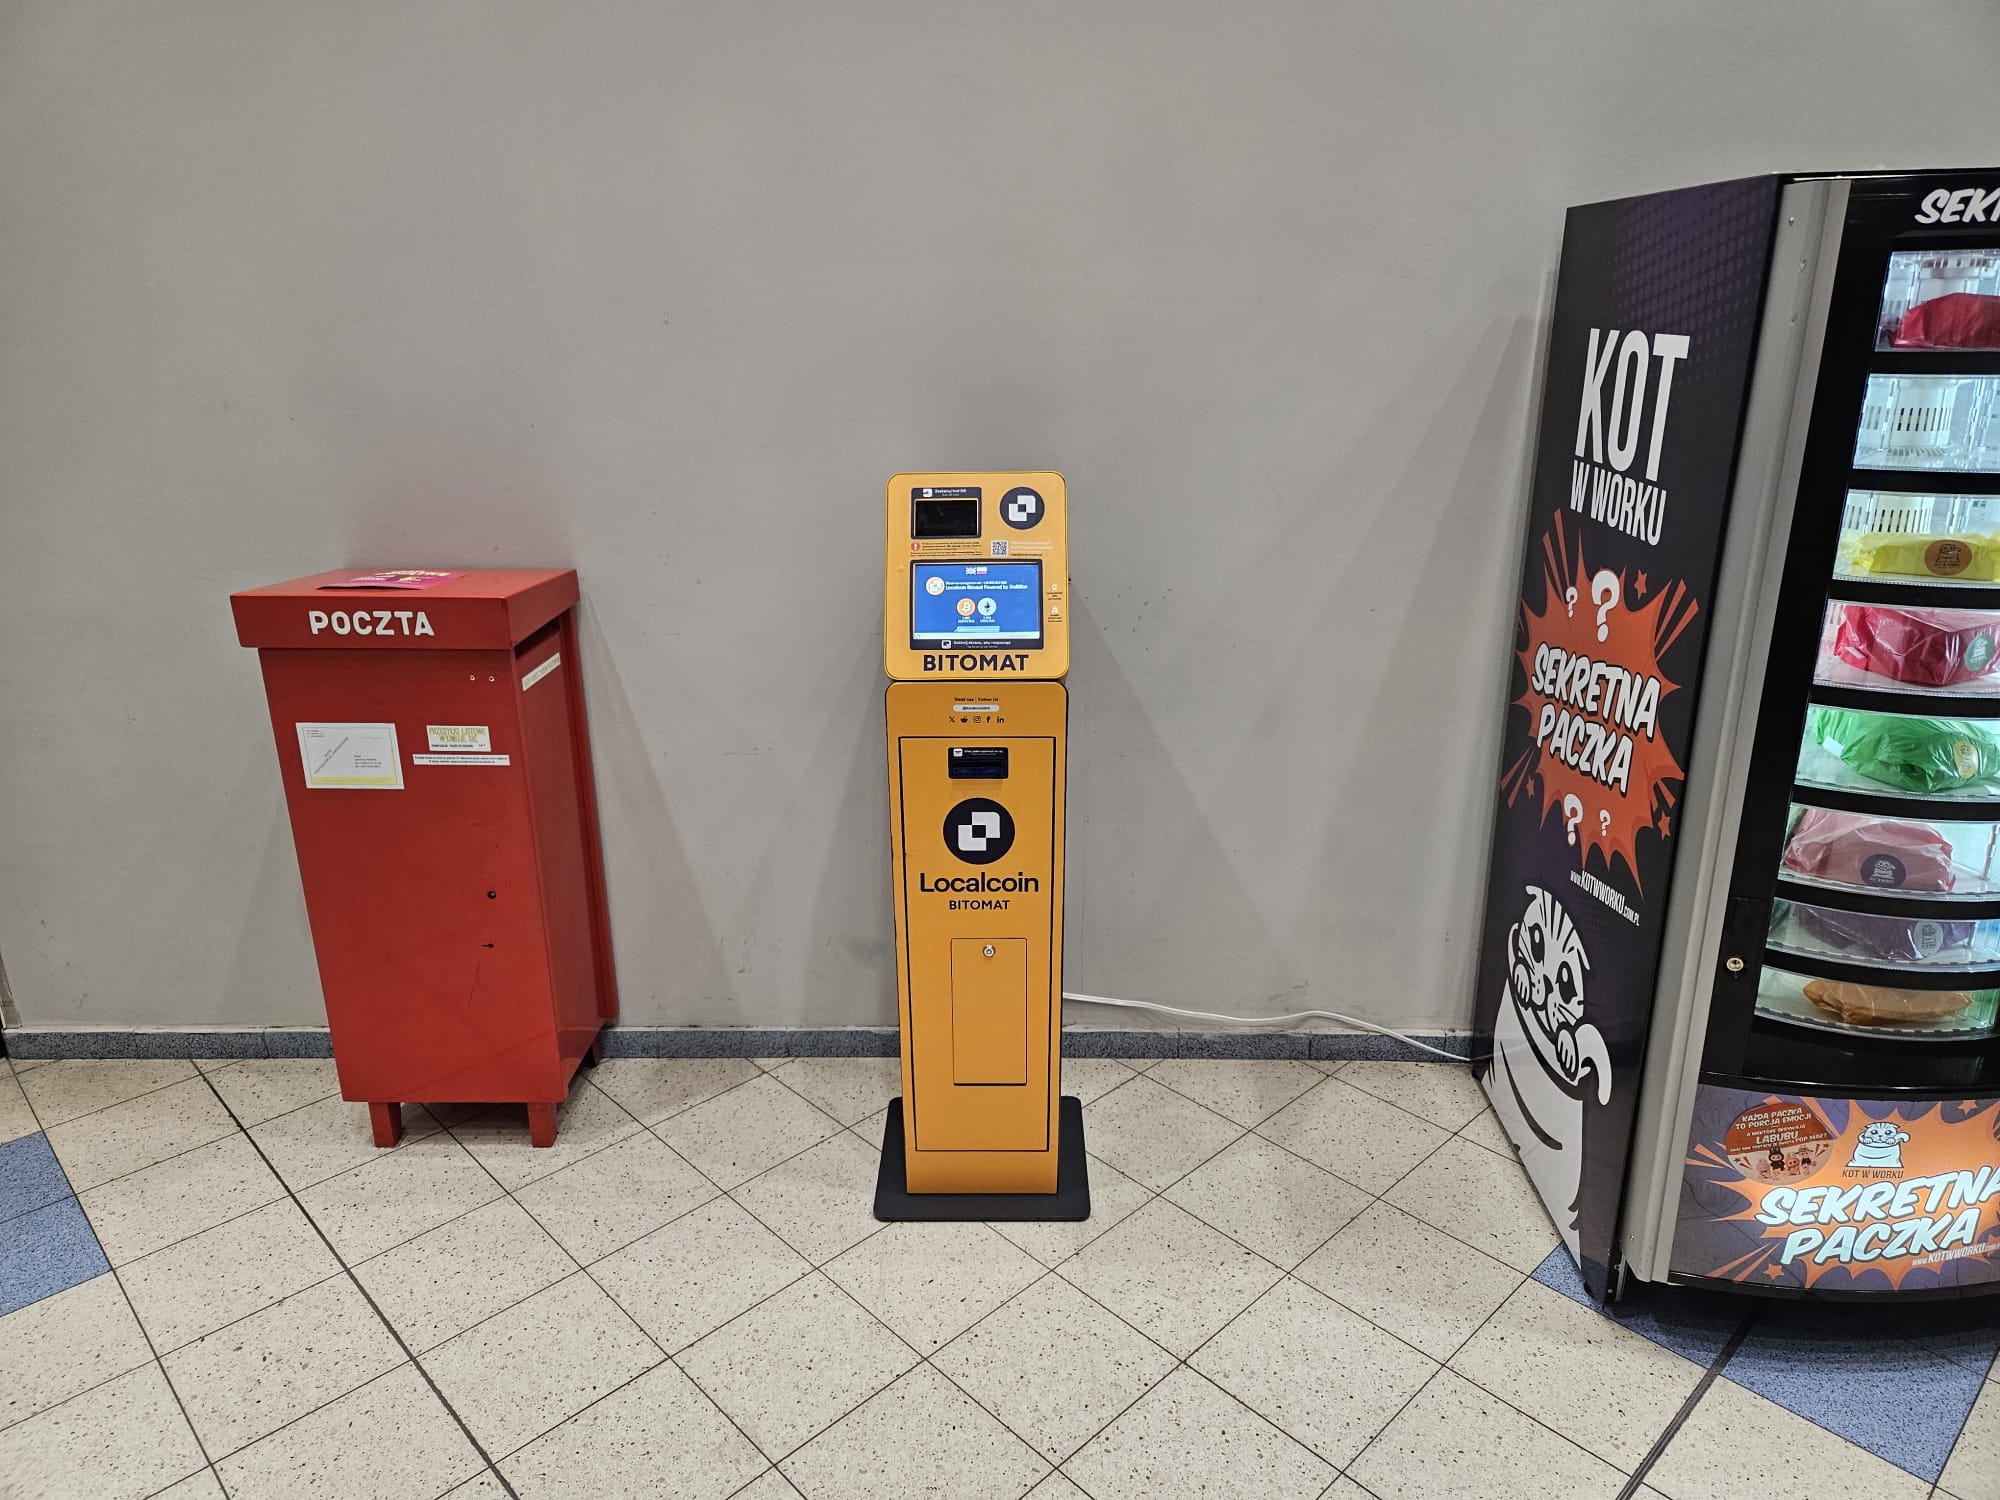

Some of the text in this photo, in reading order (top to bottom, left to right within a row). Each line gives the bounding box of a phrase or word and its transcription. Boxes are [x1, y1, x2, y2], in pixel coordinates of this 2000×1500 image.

[1914, 188, 2000, 224] SEK
[1575, 328, 1690, 482] KOT
[1570, 459, 1667, 546] W WORKU
[308, 610, 435, 636] POCZTA
[923, 654, 1029, 671] BITOMAT
[1531, 641, 1661, 740] SEKRETNA
[1536, 704, 1634, 796] PACZKA
[920, 871, 1039, 892] Localcoin
[949, 899, 1010, 910] BITOMAT
[1742, 1107, 1802, 1122] KAŻDA PACZKA
[1748, 1118, 1779, 1128] PORCJA
[1756, 1131, 1799, 1144] LABUBU
[1842, 1169, 1904, 1179] KOT W WORKU
[1780, 1208, 1981, 1266] PACZKA
